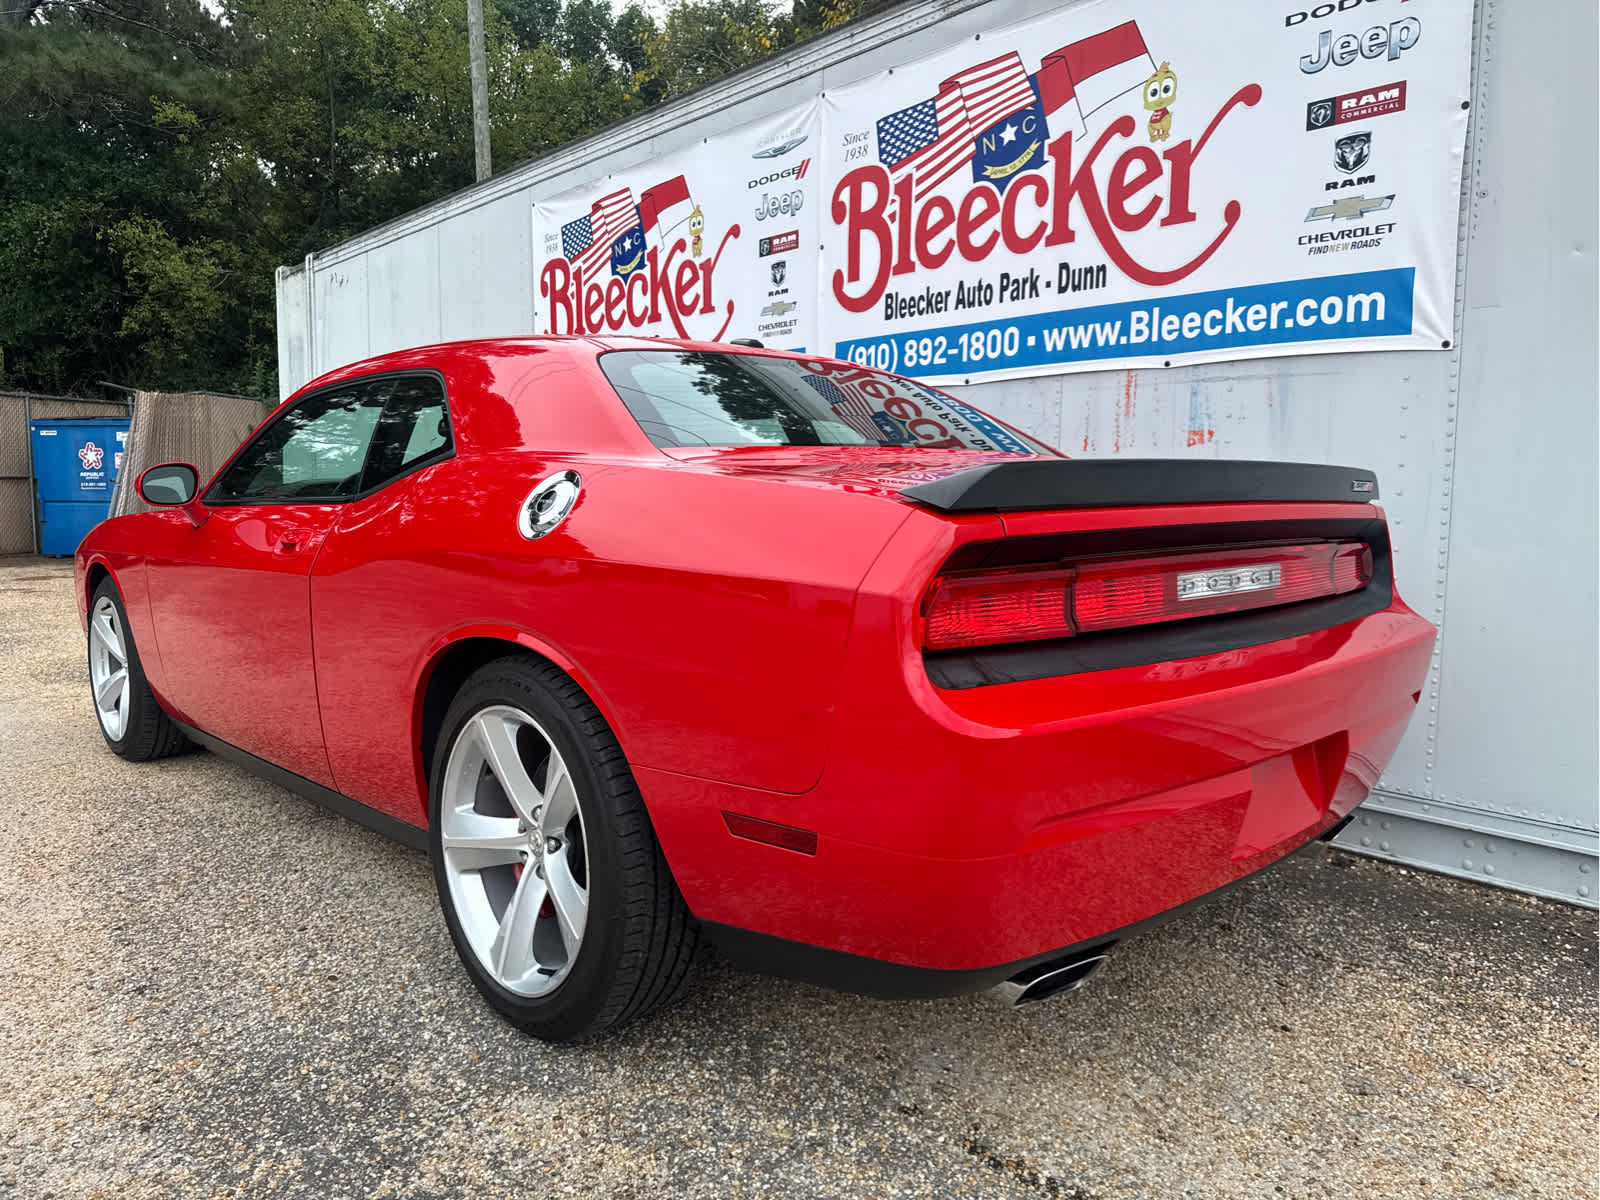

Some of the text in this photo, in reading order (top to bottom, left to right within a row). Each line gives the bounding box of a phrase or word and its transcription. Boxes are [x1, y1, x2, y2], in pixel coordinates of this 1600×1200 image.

[1300, 17, 1421, 74] Jeep
[1340, 102, 1399, 119] COMMERCIAL
[1341, 88, 1400, 110] RAM
[842, 129, 870, 147] Since
[982, 115, 1036, 155] N C
[844, 143, 870, 162] 1938
[748, 164, 802, 189] DODGE
[1325, 175, 1375, 191] RAM
[755, 189, 803, 221] Jeep
[831, 83, 1262, 312] Bleecker
[772, 234, 797, 245] RAM
[1298, 222, 1397, 246] CHEVROLET
[540, 223, 741, 341] Bleecker
[768, 288, 789, 297] RAM
[884, 285, 951, 321] Bleecker
[954, 278, 993, 310] Auto
[1000, 267, 1040, 303] Park
[1057, 261, 1107, 295] Dunn
[758, 319, 799, 332] CHEVROLET
[903, 326, 1020, 368] 892-1800
[1043, 290, 1386, 352] www.Bleecker.com
[1180, 568, 1281, 593] DODGE
